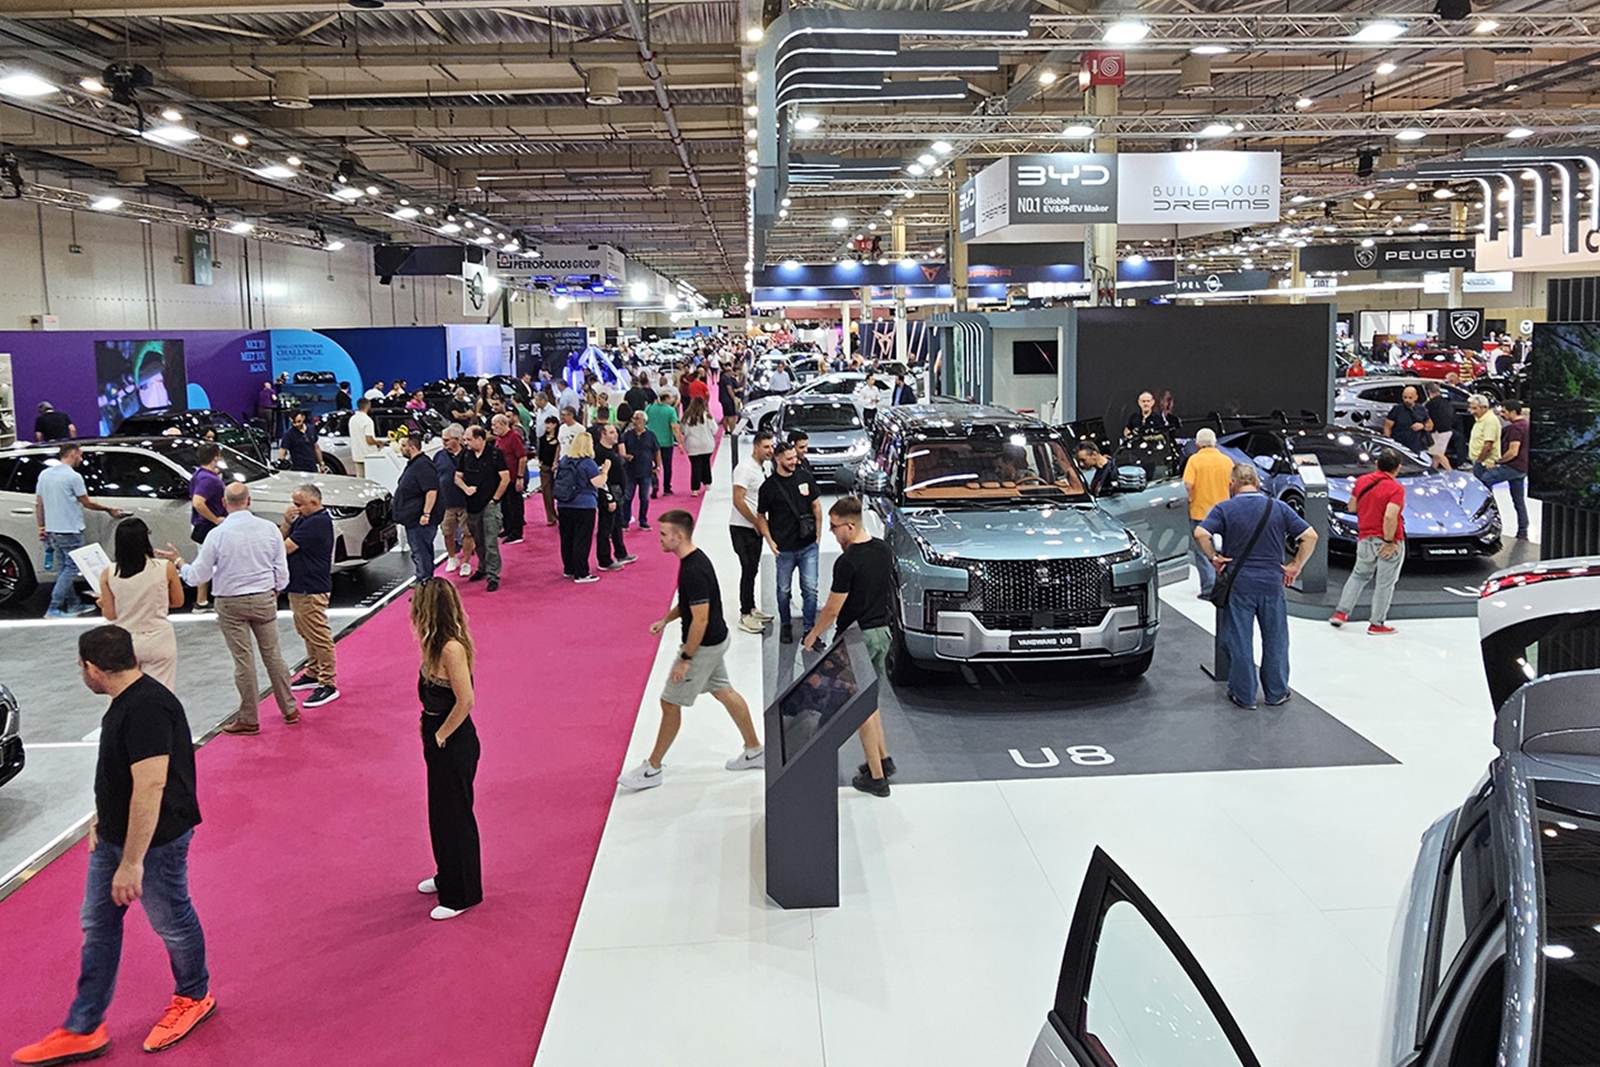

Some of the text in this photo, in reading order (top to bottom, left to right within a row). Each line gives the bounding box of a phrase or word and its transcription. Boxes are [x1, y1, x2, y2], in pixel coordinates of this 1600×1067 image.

[1017, 165, 1110, 186] BYD
[1152, 184, 1271, 197] BUILD YOUR
[1017, 197, 1040, 213] NO.1
[1042, 197, 1070, 205] Global
[1153, 198, 1271, 211] DREAMS
[1084, 204, 1109, 212] Maker
[513, 260, 572, 270] PETROPOULOS
[573, 259, 602, 269] GROUP
[1007, 744, 1116, 769] U8
